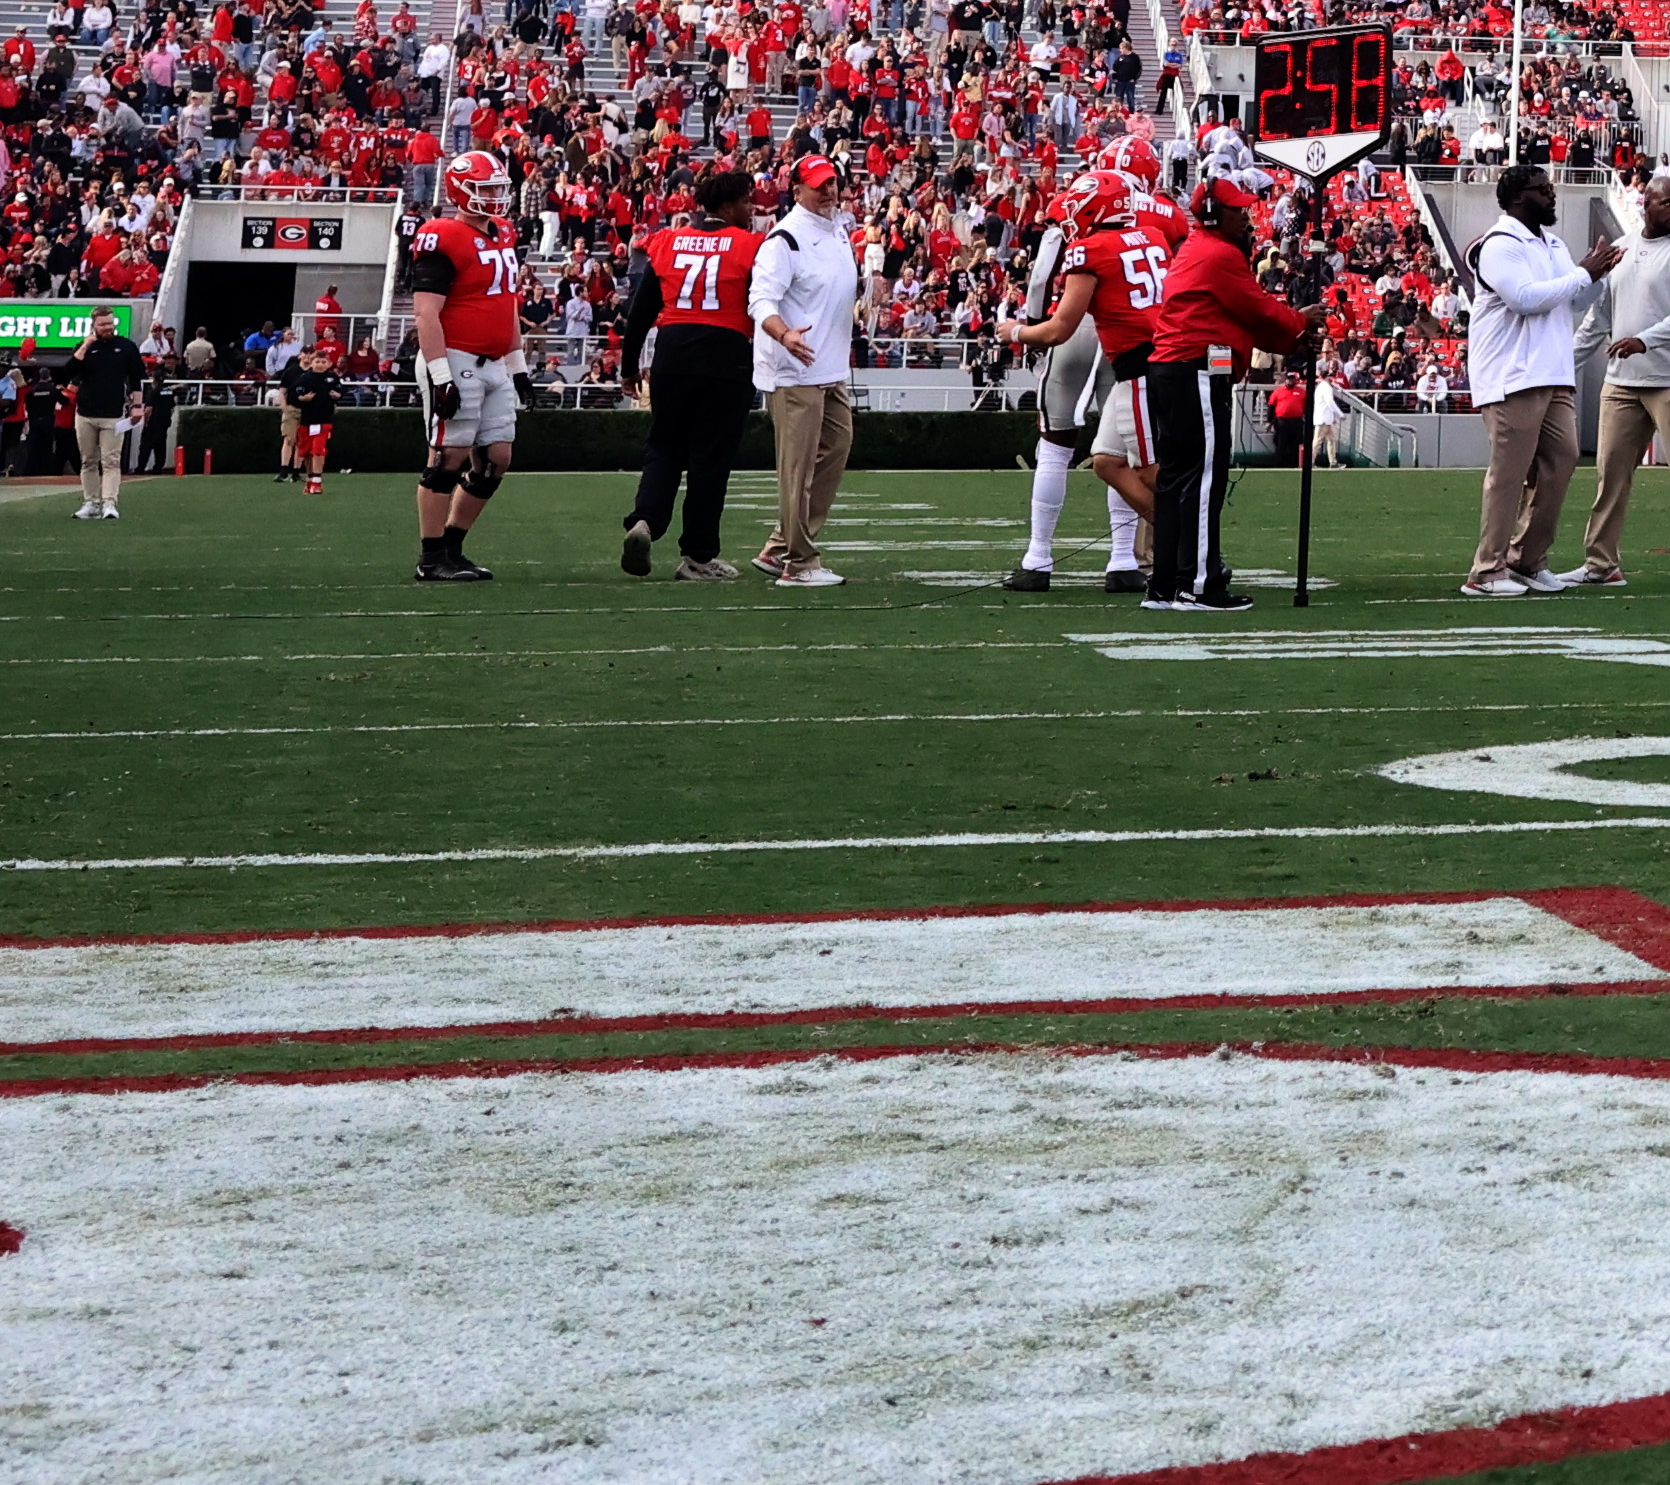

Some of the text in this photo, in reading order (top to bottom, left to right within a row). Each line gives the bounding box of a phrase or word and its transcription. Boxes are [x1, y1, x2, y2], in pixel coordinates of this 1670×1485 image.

[1259, 33, 1386, 140] 2:58
[1306, 144, 1325, 170] SEC
[252, 227, 269, 235] 139
[318, 227, 335, 236] 140
[402, 221, 416, 236] 13
[416, 233, 438, 252] 78
[672, 236, 733, 252] GREENE III
[1063, 245, 1086, 269] 56
[478, 247, 519, 296] 78
[673, 253, 722, 310] 71
[1120, 249, 1168, 310] 56
